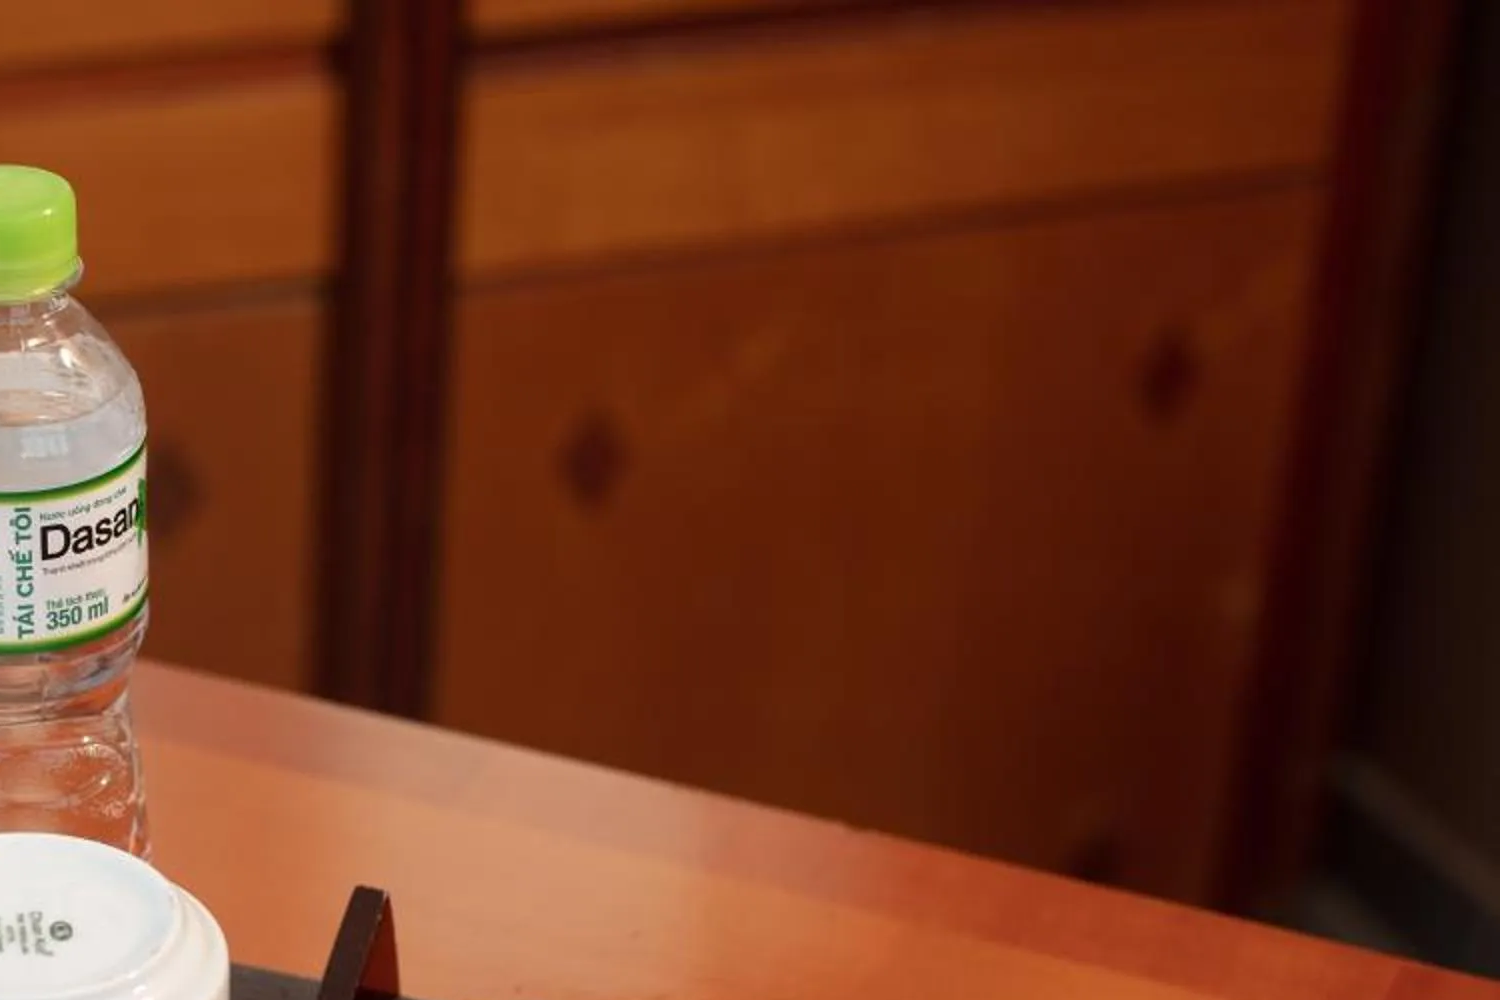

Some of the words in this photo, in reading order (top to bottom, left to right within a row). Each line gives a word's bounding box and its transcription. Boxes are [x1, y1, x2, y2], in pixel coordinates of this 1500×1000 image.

[40, 497, 138, 561] Dasan
[45, 606, 83, 631] 350
[87, 595, 110, 620] ml
